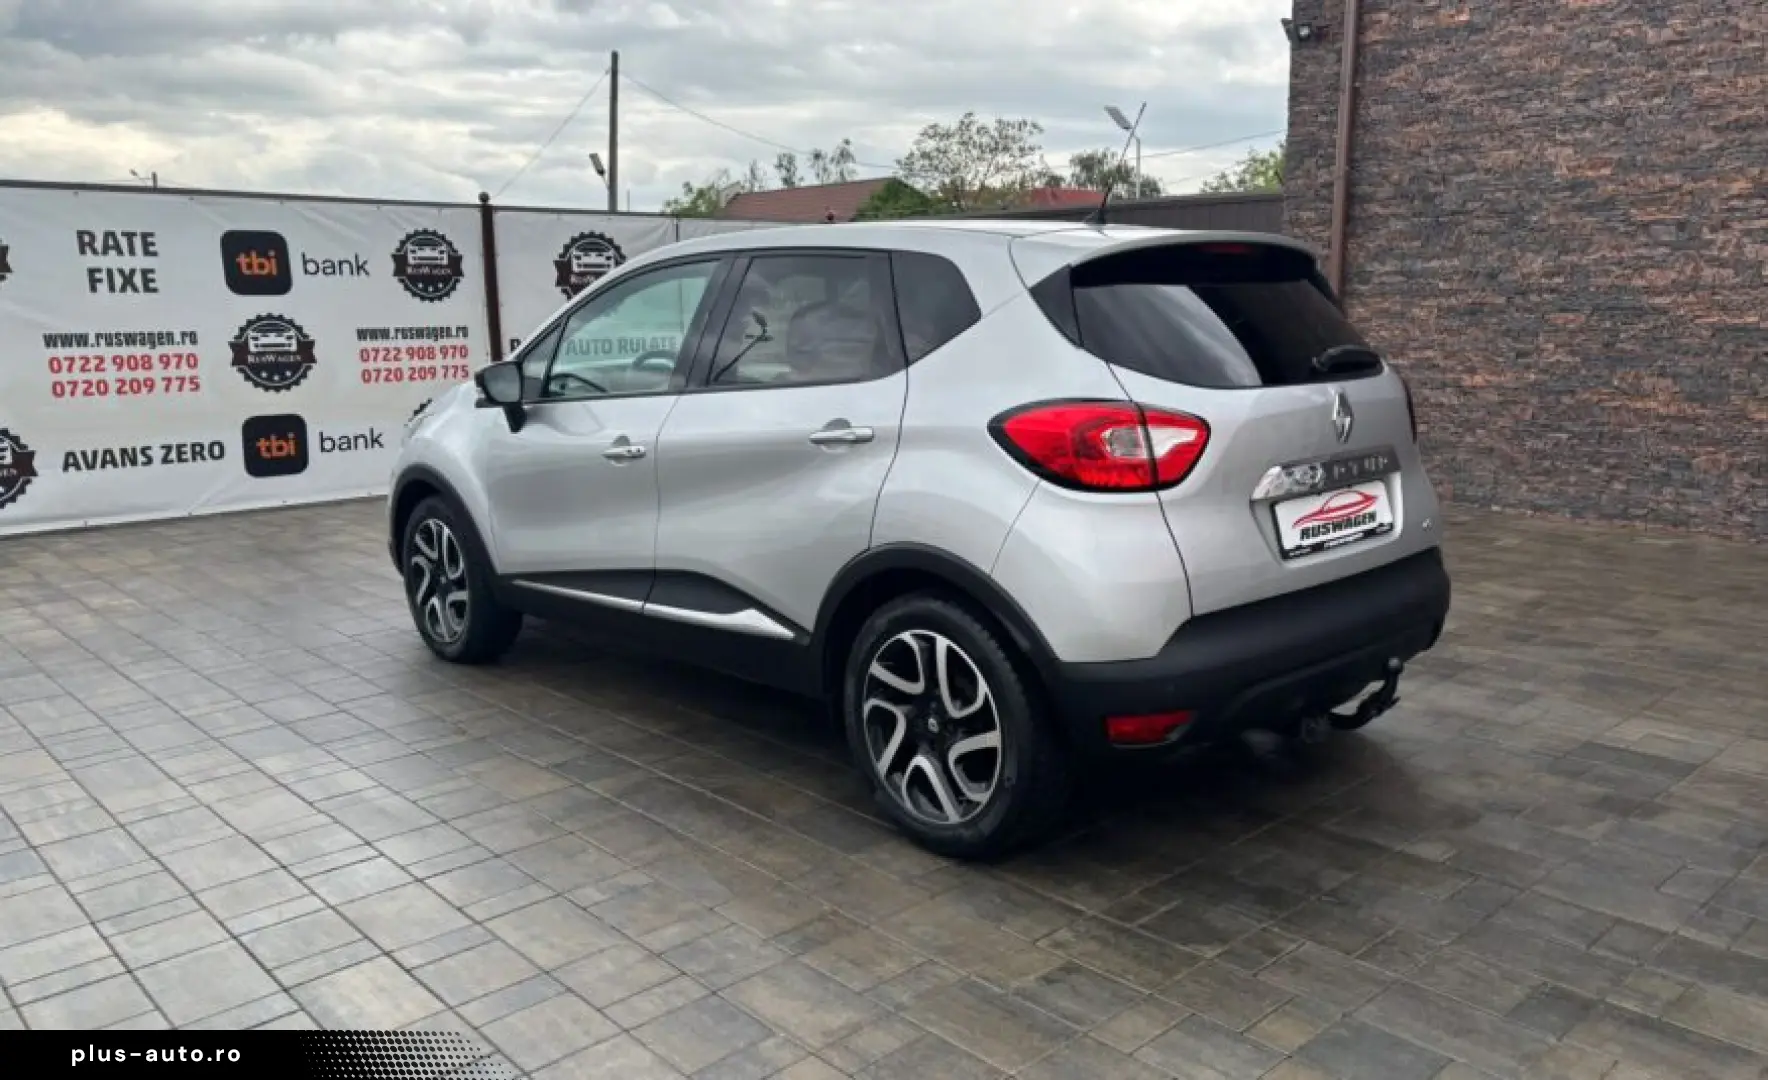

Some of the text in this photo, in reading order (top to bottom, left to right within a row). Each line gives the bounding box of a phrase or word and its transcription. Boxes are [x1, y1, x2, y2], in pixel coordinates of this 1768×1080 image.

[76, 229, 159, 257] RATE
[236, 250, 370, 277] tbi bank
[86, 267, 160, 294] FIXE
[43, 330, 199, 349] www.ruswagen.ro
[360, 344, 469, 362] 0722 908 970
[48, 352, 199, 374] 0722 908 970
[361, 364, 469, 384] 0720 209 775
[52, 375, 200, 398] 0720 209 775
[62, 440, 225, 473] AVANS ZERO
[256, 428, 384, 459] tbi bank
[1300, 511, 1377, 540] RUSWAGEN
